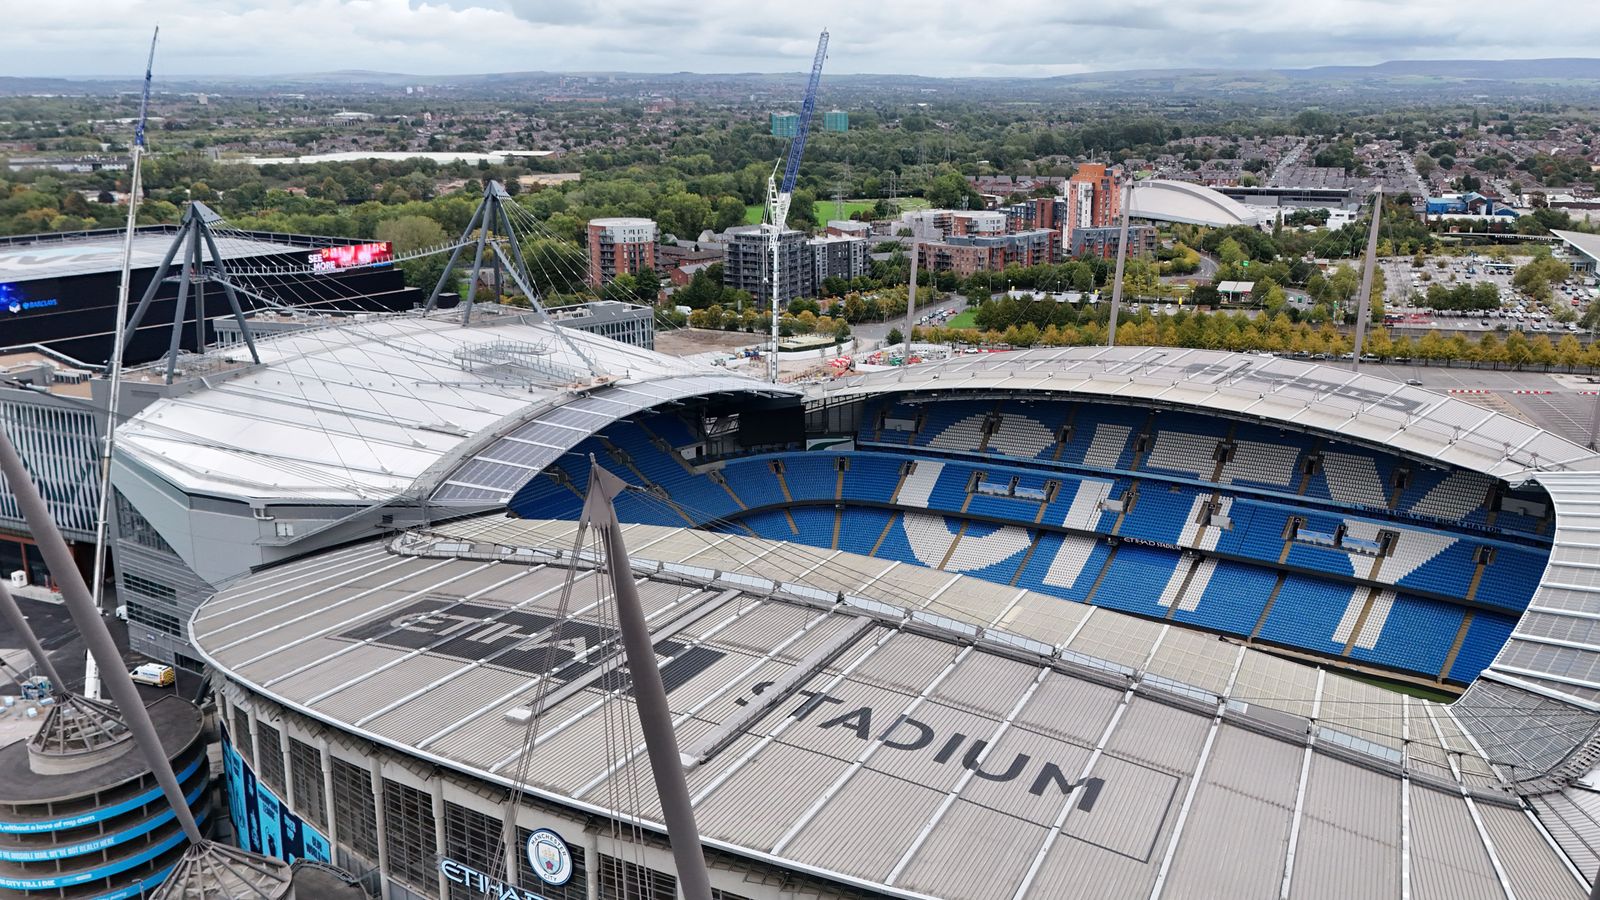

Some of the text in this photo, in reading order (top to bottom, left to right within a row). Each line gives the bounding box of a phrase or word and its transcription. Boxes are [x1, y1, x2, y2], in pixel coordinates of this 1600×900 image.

[308, 253, 324, 264] SEE
[313, 261, 337, 272] MORE
[29, 299, 58, 309] BARCLAYS
[1123, 537, 1182, 551] ETIHAD STADIUM
[530, 832, 567, 857] MANCHESTER
[543, 873, 558, 882] CITY
